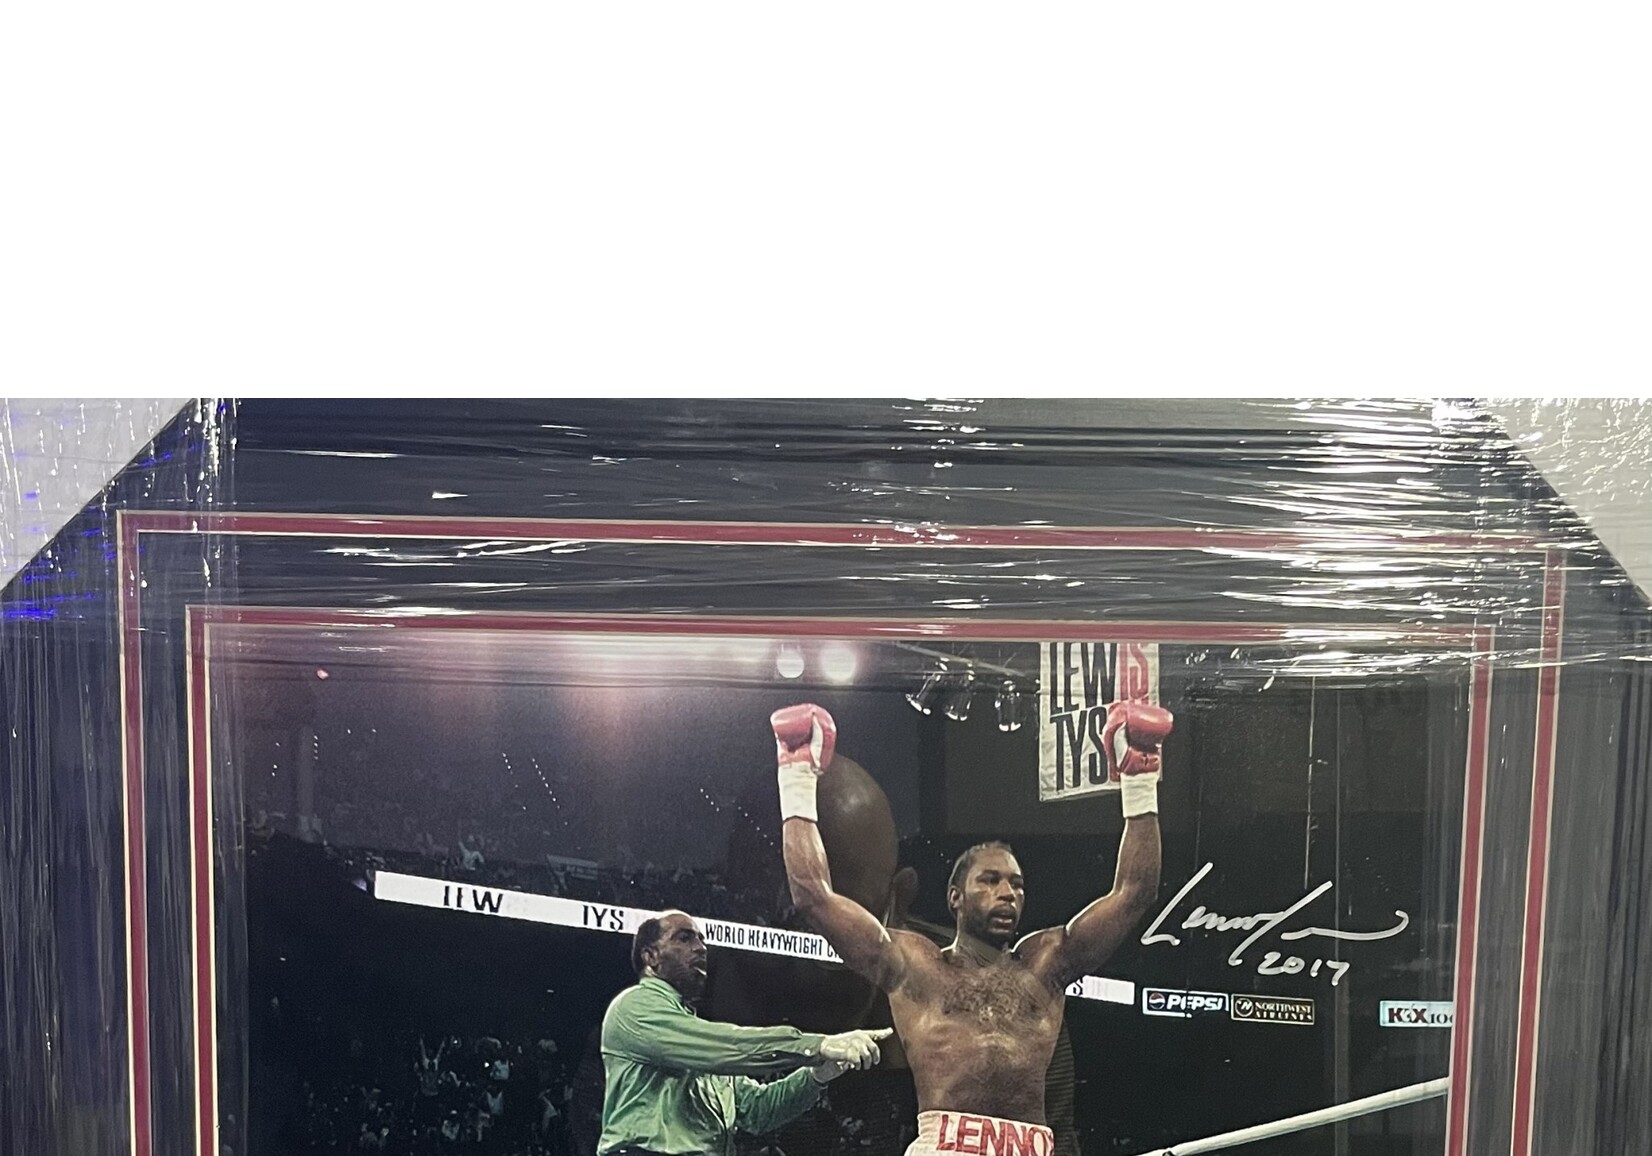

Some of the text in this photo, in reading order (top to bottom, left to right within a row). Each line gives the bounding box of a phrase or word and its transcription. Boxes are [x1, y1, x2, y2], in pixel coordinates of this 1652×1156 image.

[1050, 642, 1149, 716] LEWIS
[1050, 706, 1121, 791] TYS
[705, 922, 745, 945] WORLD
[748, 929, 823, 956] HEAVYWEIGHT
[1257, 951, 1350, 986] 2017
[1166, 993, 1225, 1012] PEPSI
